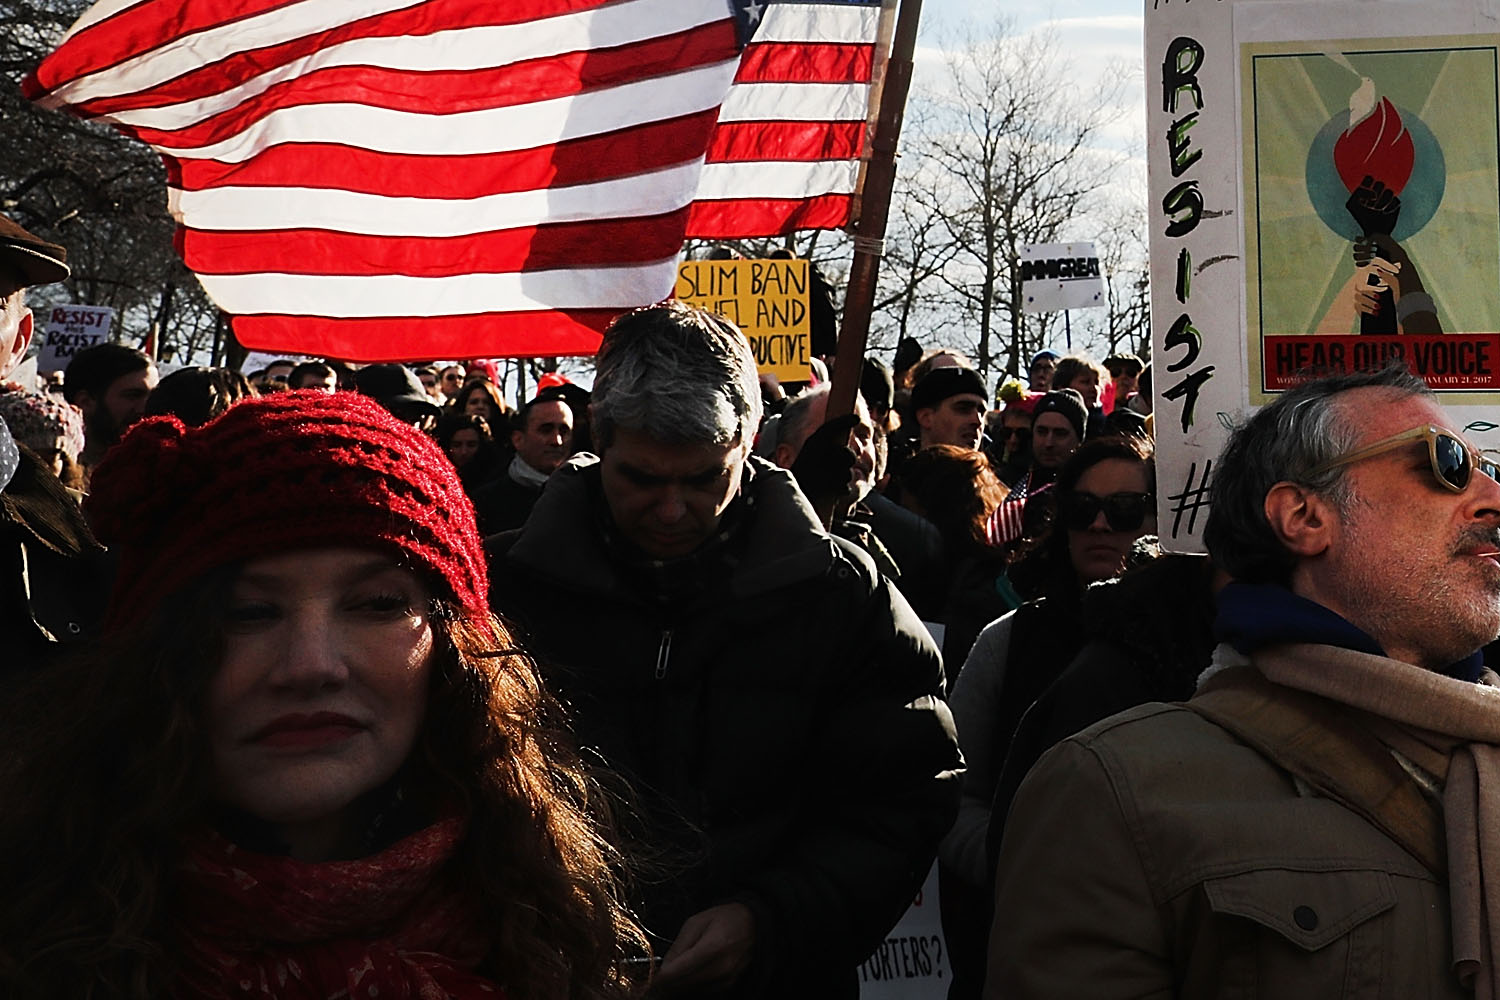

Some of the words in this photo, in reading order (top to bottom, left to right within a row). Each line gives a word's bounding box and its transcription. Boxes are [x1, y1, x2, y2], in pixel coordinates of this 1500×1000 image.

[1162, 36, 1216, 434] RESIST
[751, 263, 807, 296] BAN
[51, 307, 107, 328] RESIST
[757, 298, 806, 328] AND
[46, 330, 101, 347] RACIST
[54, 344, 82, 358] BA
[1277, 341, 1346, 376] HEAR
[1352, 341, 1405, 372] OUR
[1414, 341, 1491, 375] VOICE
[1473, 375, 1492, 384] 2017
